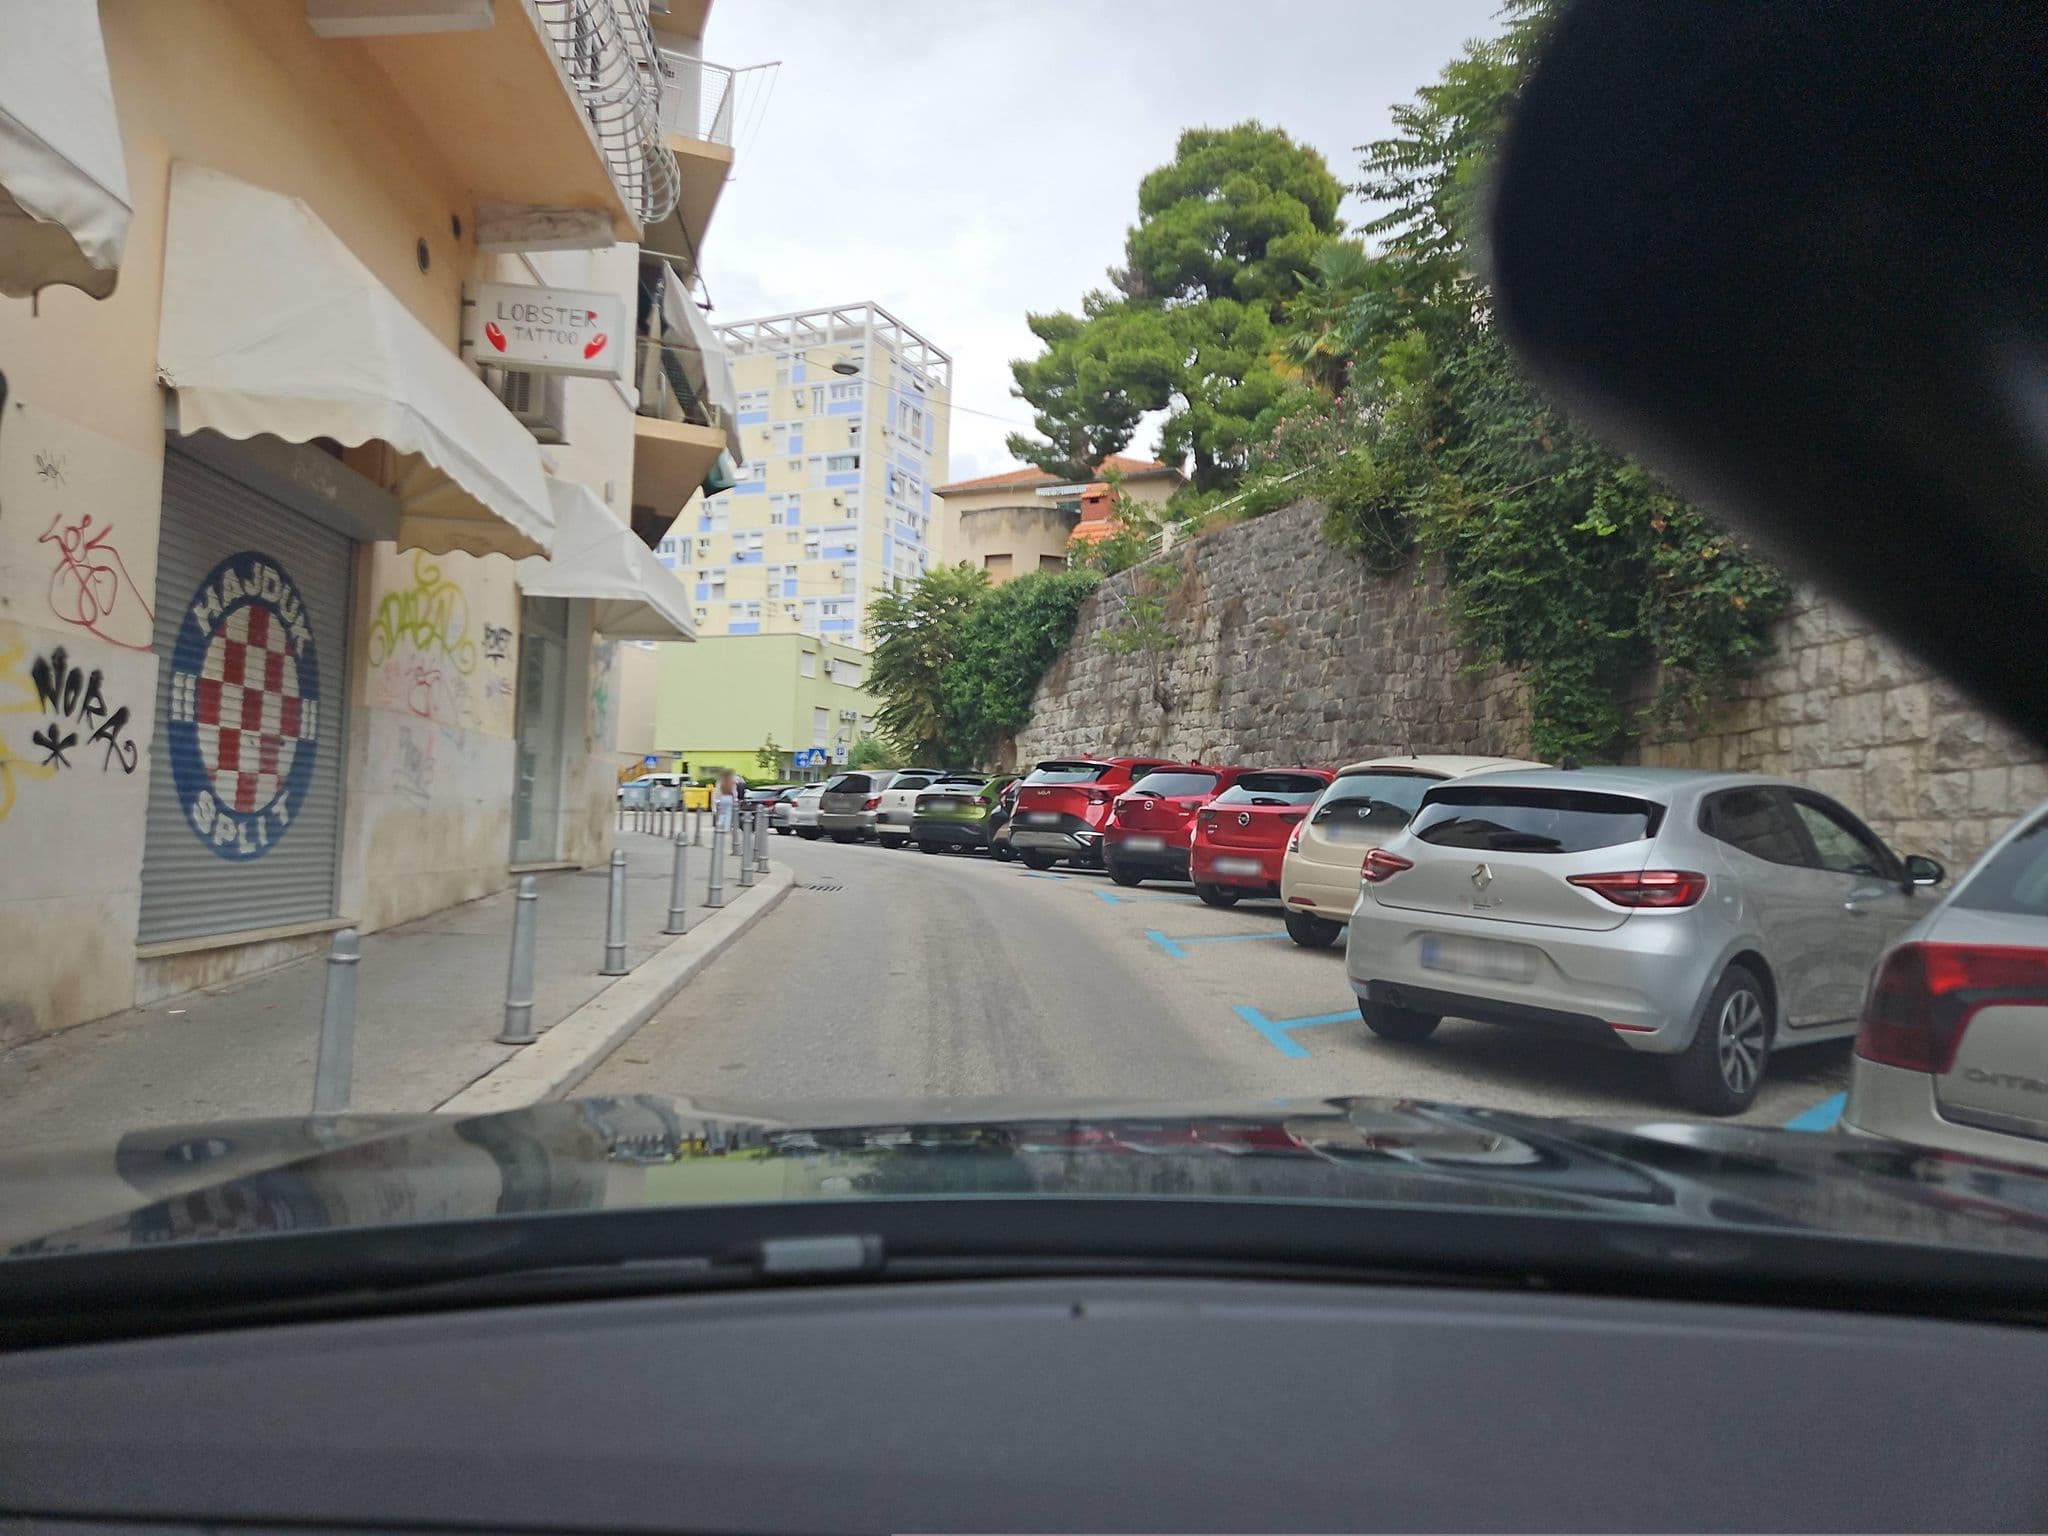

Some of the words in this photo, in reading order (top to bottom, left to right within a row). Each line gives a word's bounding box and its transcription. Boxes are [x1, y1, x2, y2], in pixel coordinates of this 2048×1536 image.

[497, 302, 597, 328] LOBSTER
[515, 326, 578, 345] TATTOO
[194, 561, 312, 659] HAJDUK
[32, 647, 138, 774] NORA
[193, 790, 291, 854] SPLIT
